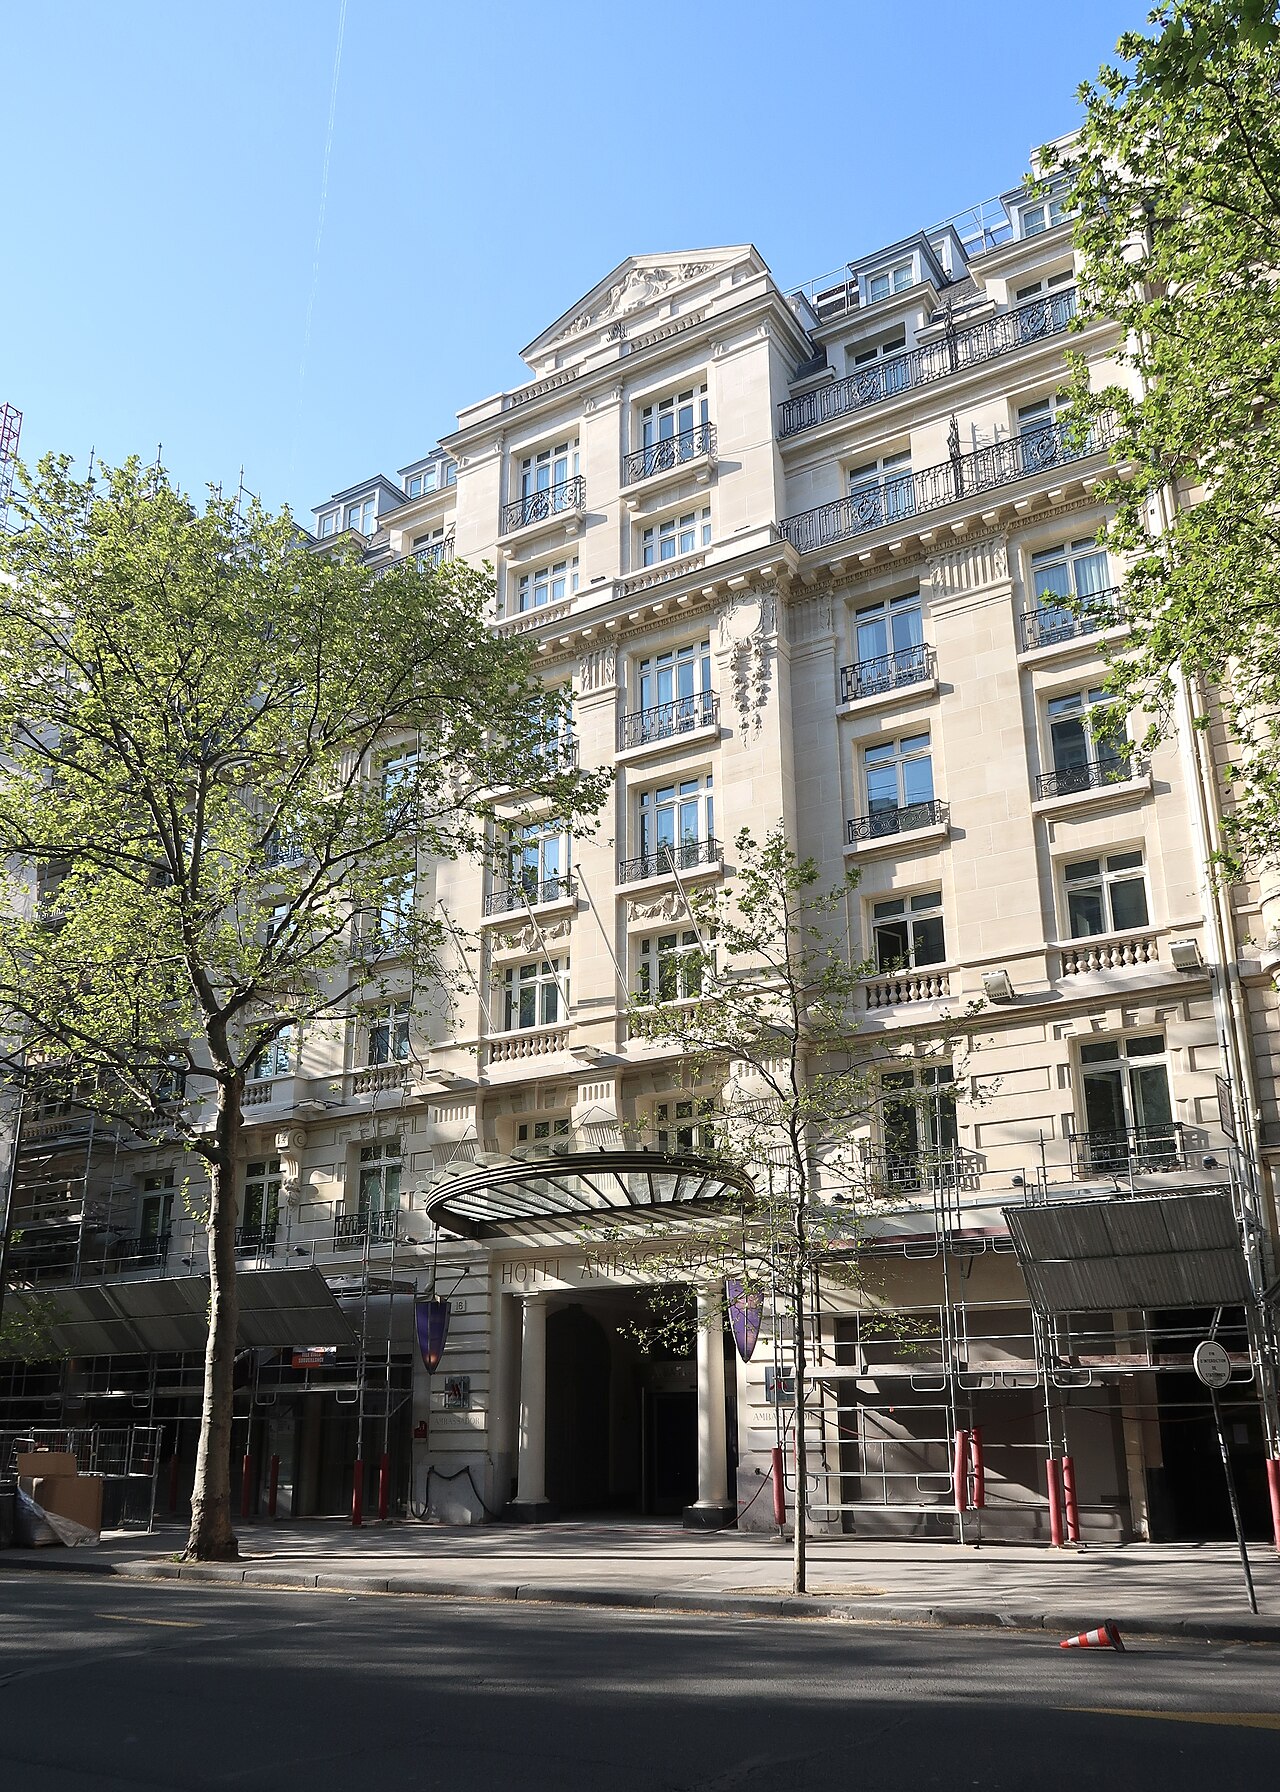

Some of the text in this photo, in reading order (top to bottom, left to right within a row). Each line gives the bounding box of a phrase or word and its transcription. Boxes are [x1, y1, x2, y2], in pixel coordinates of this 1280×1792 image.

[501, 1246, 738, 1285] HOTEL AMBASDOR
[455, 1301, 464, 1311] 16
[433, 1416, 481, 1426] AMBASSADOR
[753, 1411, 813, 1421] AMBASSAR
